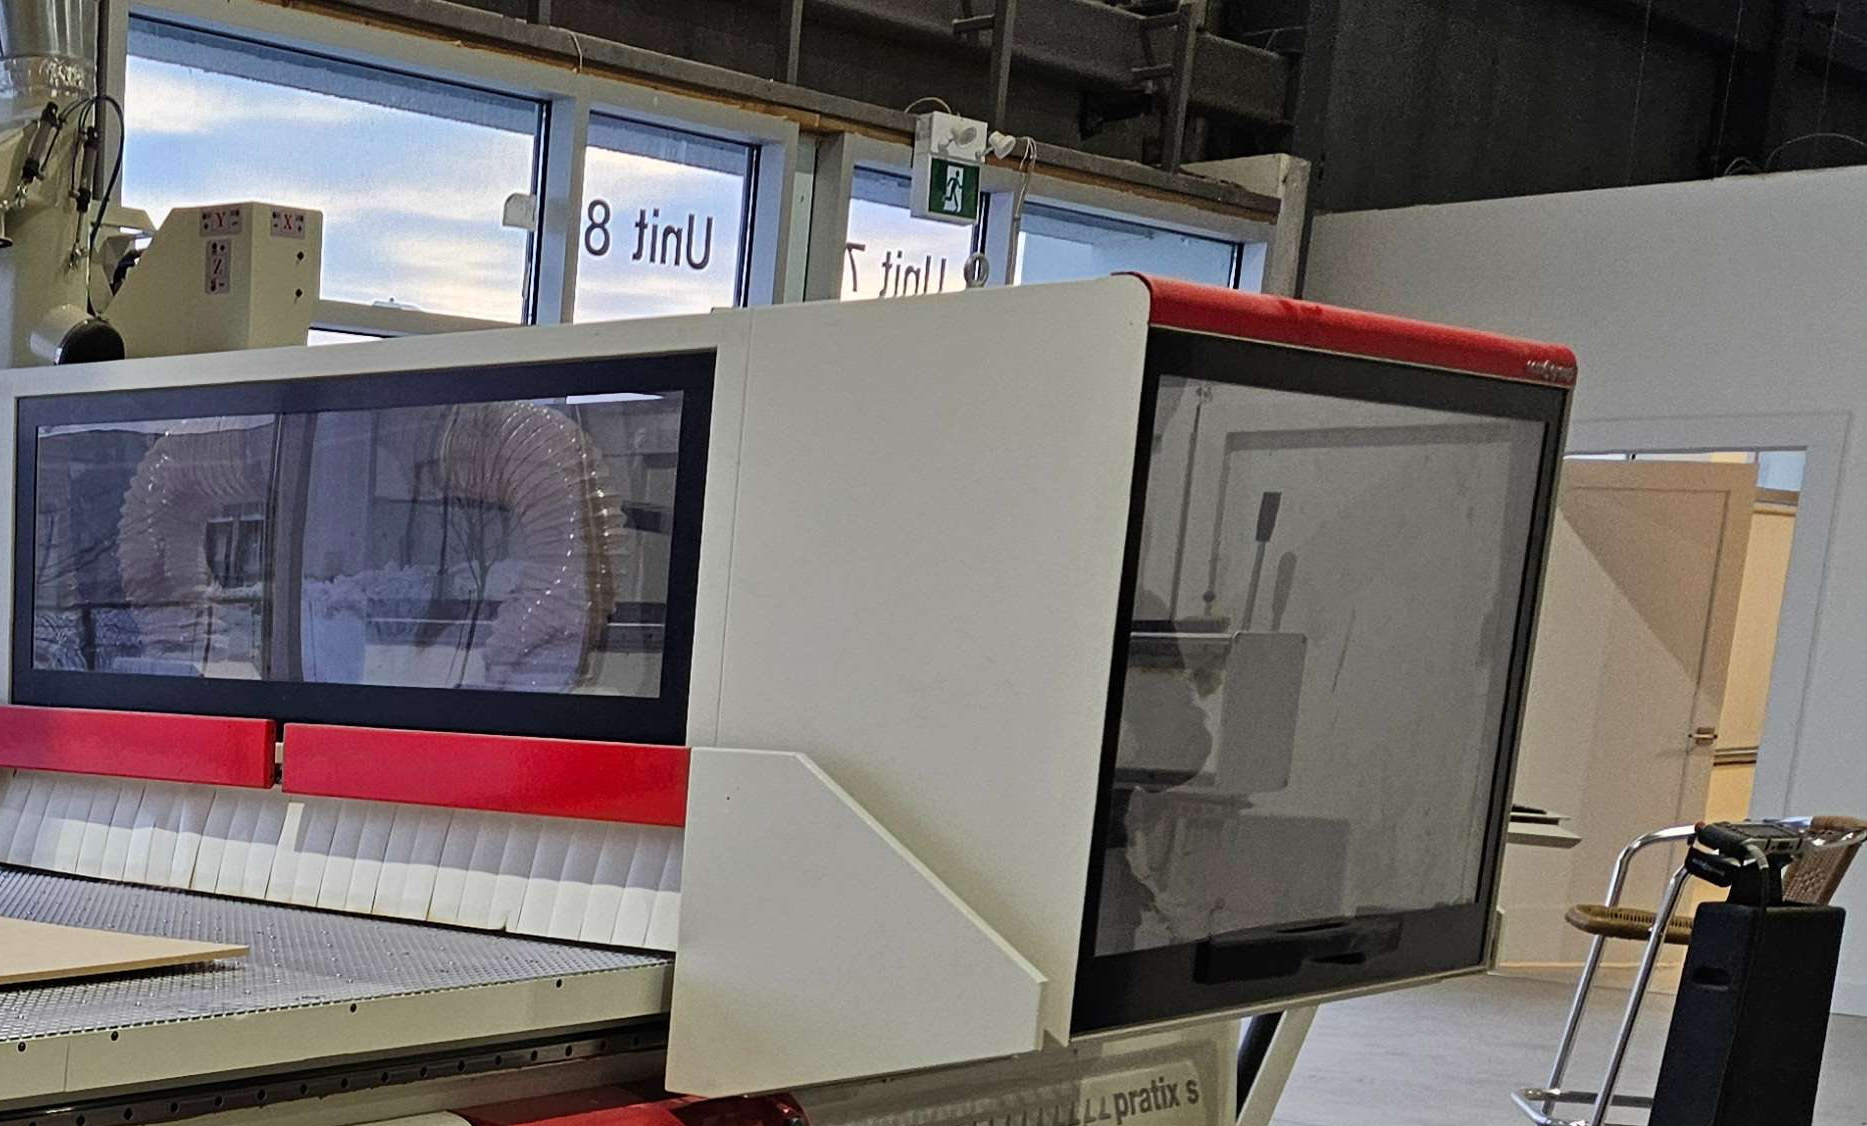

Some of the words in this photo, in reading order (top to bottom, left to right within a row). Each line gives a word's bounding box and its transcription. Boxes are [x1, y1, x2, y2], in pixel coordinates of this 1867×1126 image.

[215, 211, 226, 228] Y
[283, 213, 293, 231] X
[1113, 1075, 1181, 1126] pratix
[1185, 1078, 1200, 1105] s
